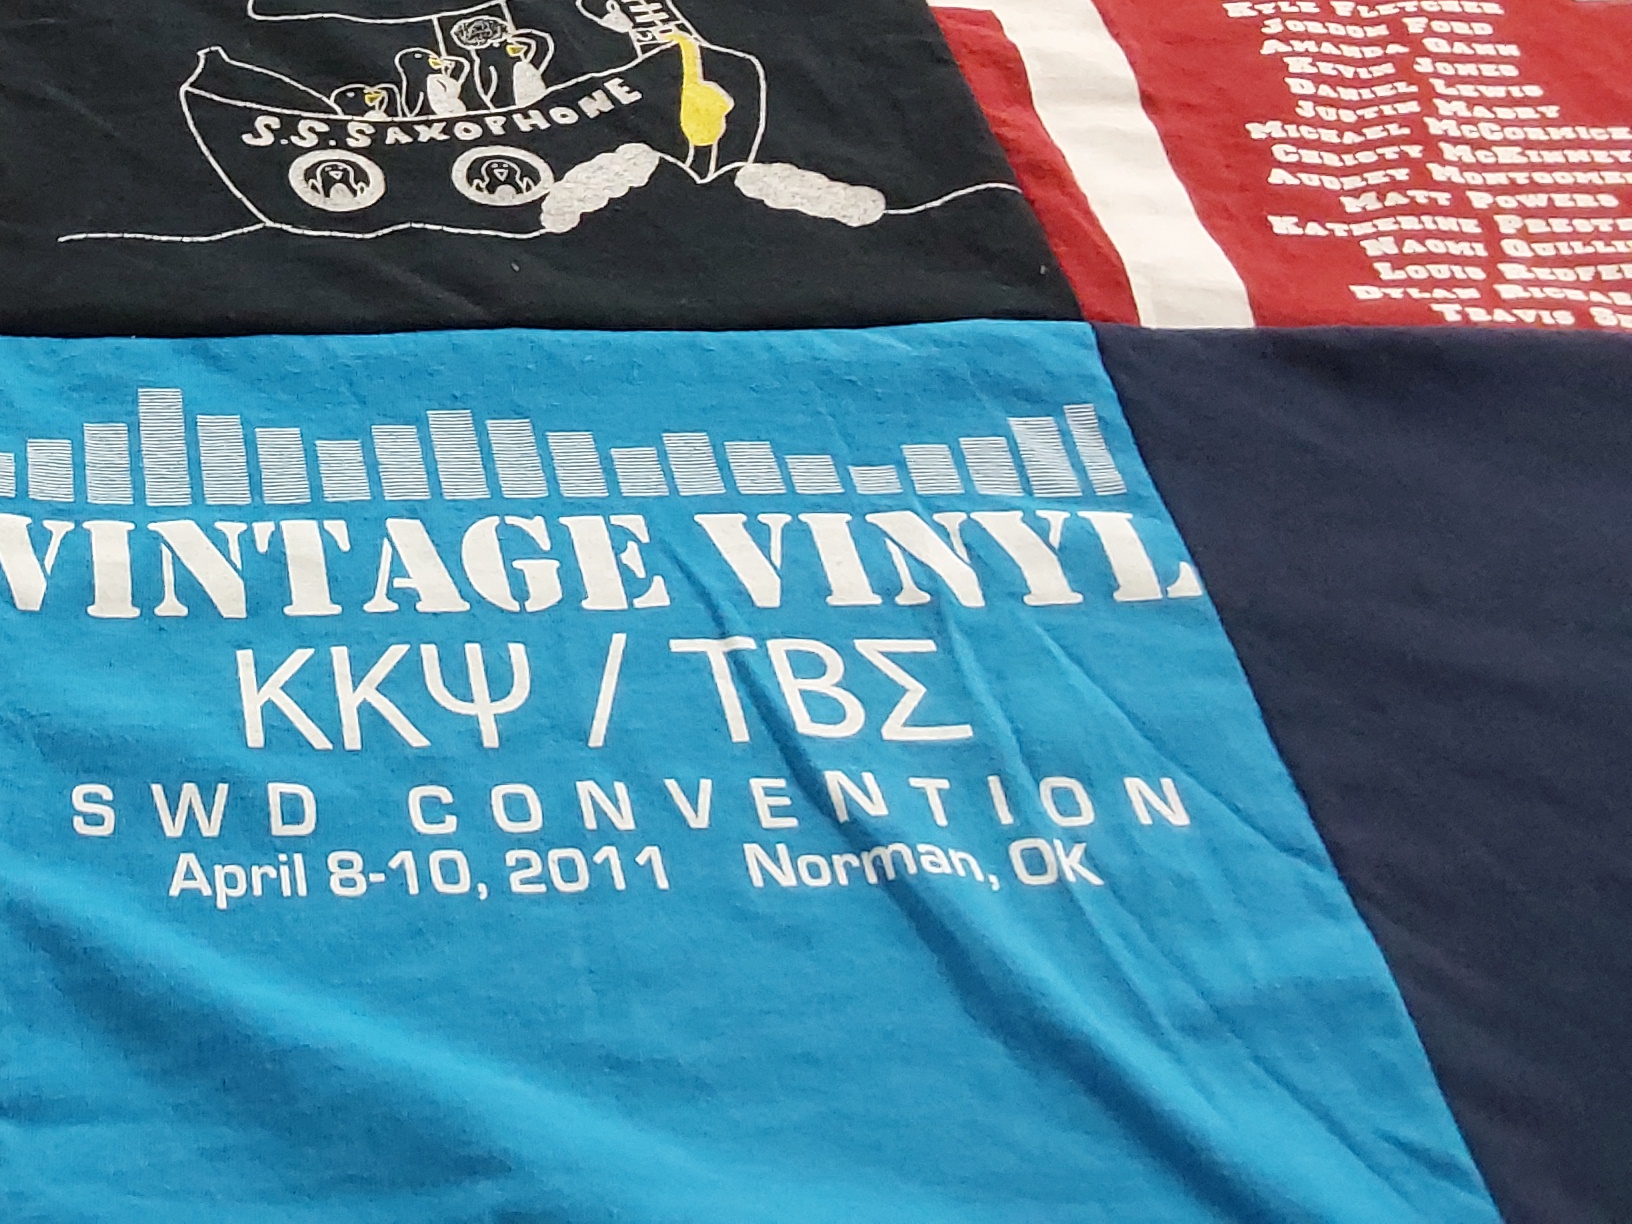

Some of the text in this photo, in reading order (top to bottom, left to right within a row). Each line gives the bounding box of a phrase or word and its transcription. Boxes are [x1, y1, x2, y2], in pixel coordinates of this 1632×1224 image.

[1222, 0, 1506, 19] KYLE FLETCHER
[1401, 16, 1494, 37] FORD
[1259, 38, 1411, 59] AMANDA
[1282, 55, 1520, 79] KEVIN JONES
[1283, 76, 1544, 101] DANIEL LEWIS
[1294, 99, 1422, 123] JUSTIN
[1244, 120, 1412, 144] MICHAEL
[1270, 143, 1425, 167] CHRISTY
[1267, 162, 1632, 191] AUDREY MONTGOME
[1339, 188, 1620, 214] MATT POWERS
[1266, 213, 1484, 238] KATHERINE
[1359, 235, 1632, 258] NAOMI QUILLI
[1372, 261, 1488, 281] LOUIS
[1347, 283, 1482, 301] DYLAN
[1429, 302, 1576, 326] TRAVIS
[693, 508, 1203, 607] VINYL
[408, 768, 1191, 835] CONVENTION
[167, 836, 1106, 911] April 8-10, 2011 Norman, OK
